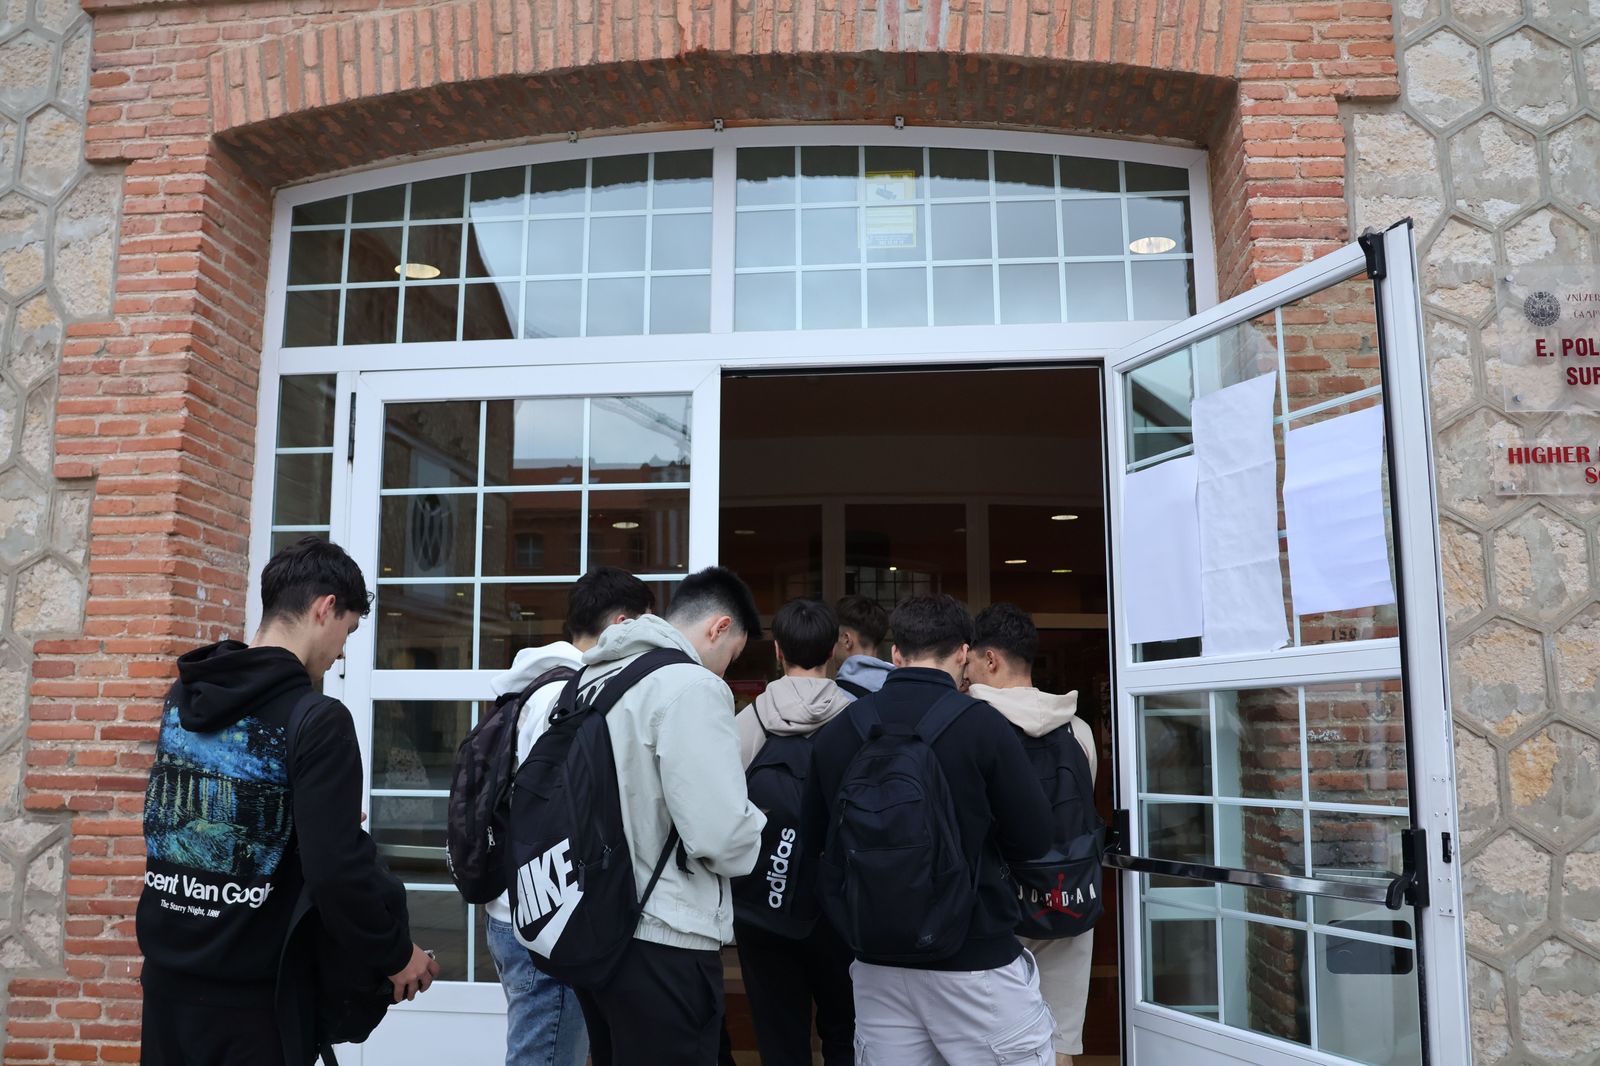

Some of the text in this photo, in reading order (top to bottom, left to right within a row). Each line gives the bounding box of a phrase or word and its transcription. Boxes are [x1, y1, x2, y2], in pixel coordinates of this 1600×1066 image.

[1536, 339, 1554, 357] E.
[1508, 446, 1591, 464] HIGHER
[1585, 467, 1600, 484] S
[766, 828, 796, 908] adidas
[183, 875, 219, 902] Van
[517, 838, 579, 929] NIKE
[160, 899, 169, 909] The
[170, 902, 187, 914] Starry
[187, 905, 206, 917] Night,
